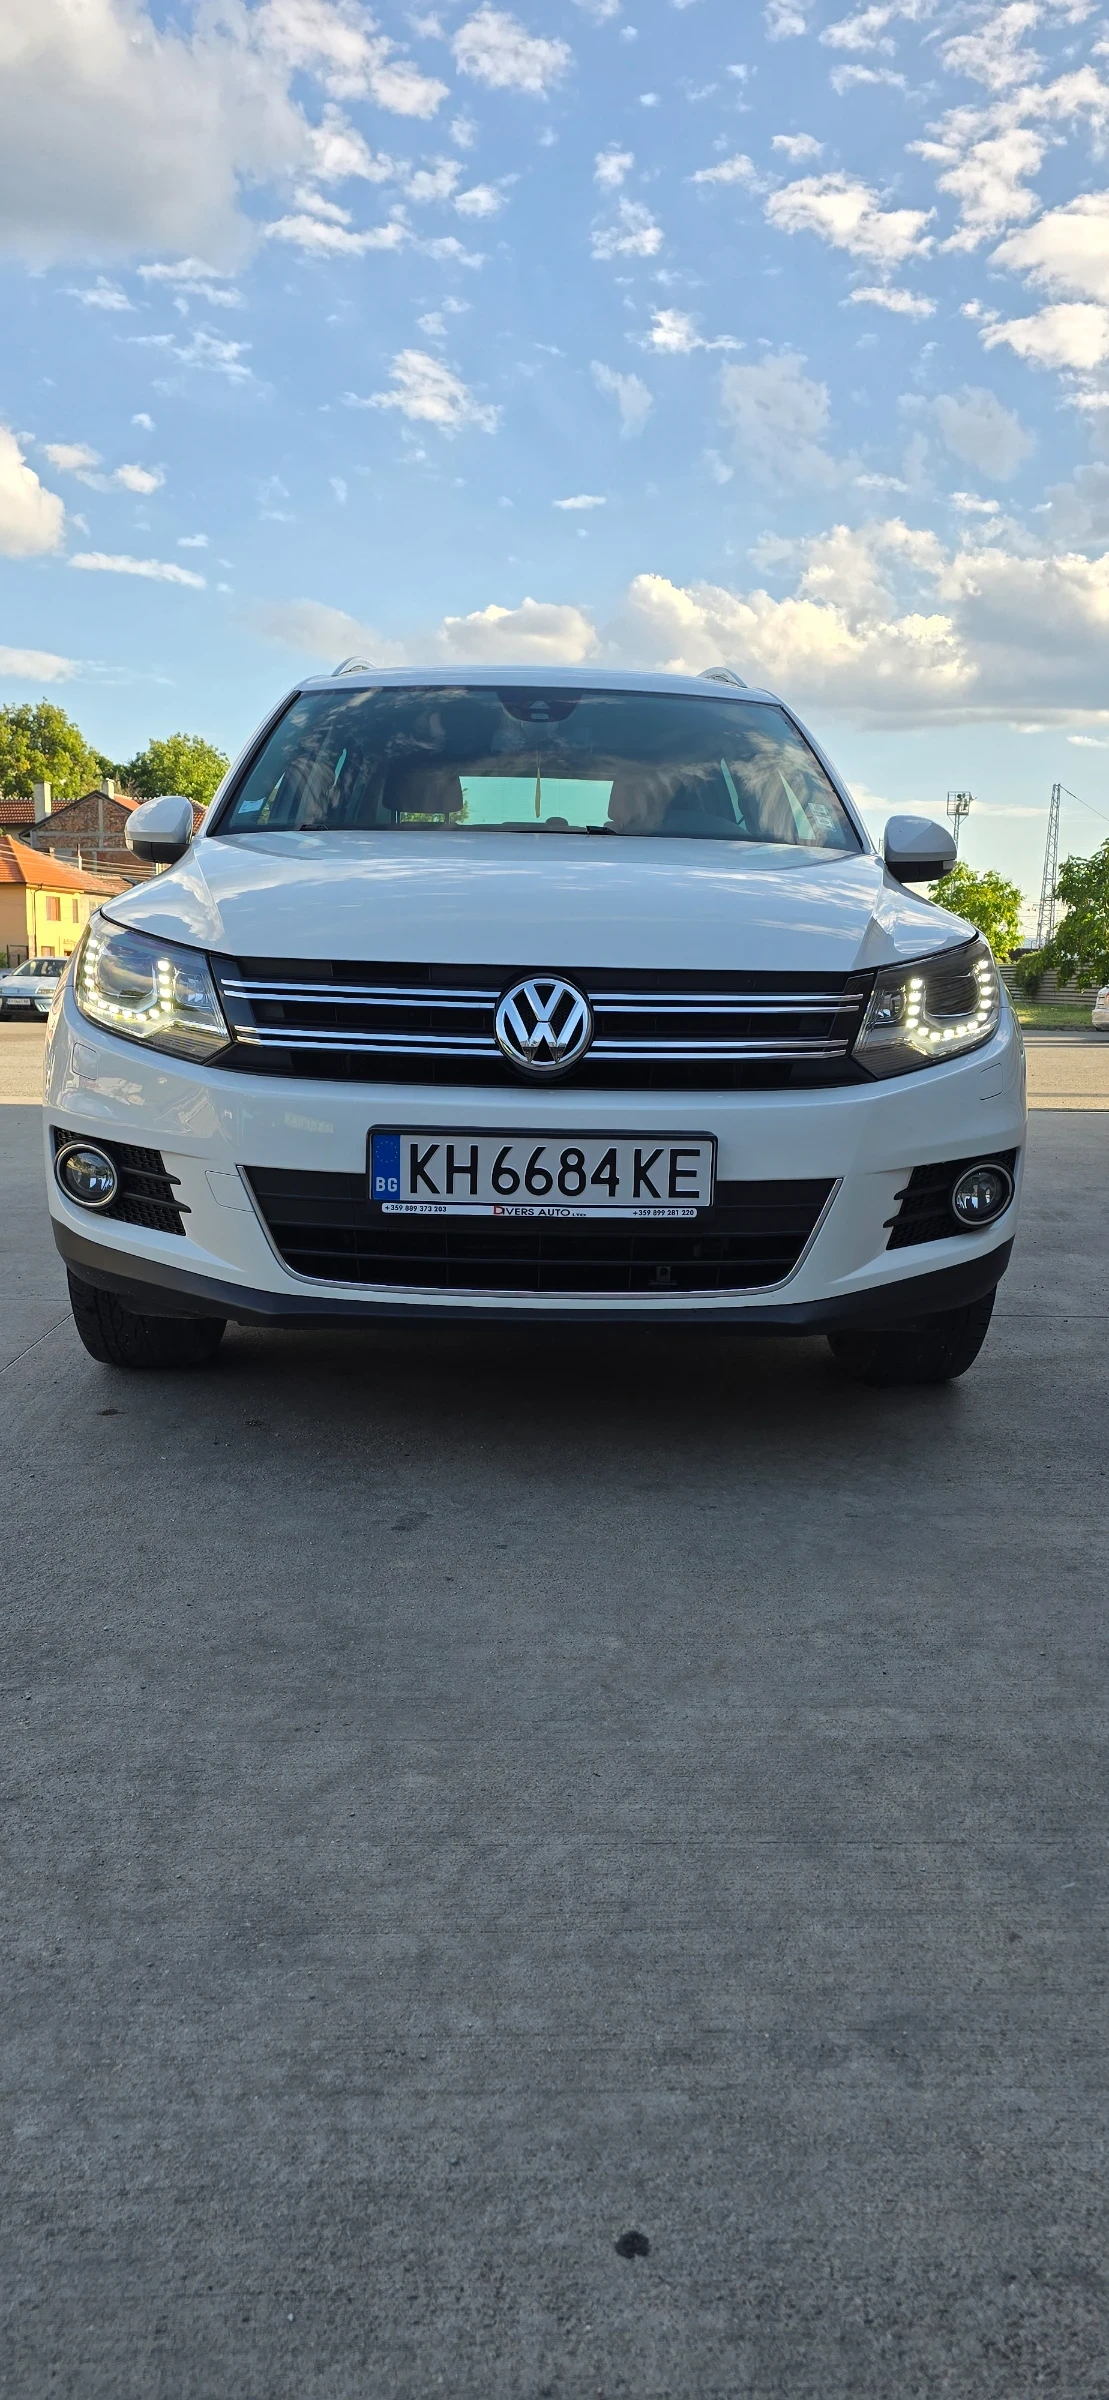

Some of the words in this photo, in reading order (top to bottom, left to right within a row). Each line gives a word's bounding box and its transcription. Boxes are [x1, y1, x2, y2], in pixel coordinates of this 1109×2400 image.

[498, 979, 588, 1066] VW
[375, 1176, 398, 1192] BG
[493, 1205, 535, 1216] DIVERS
[537, 1208, 571, 1217] AUTO
[667, 1209, 680, 1217] 281
